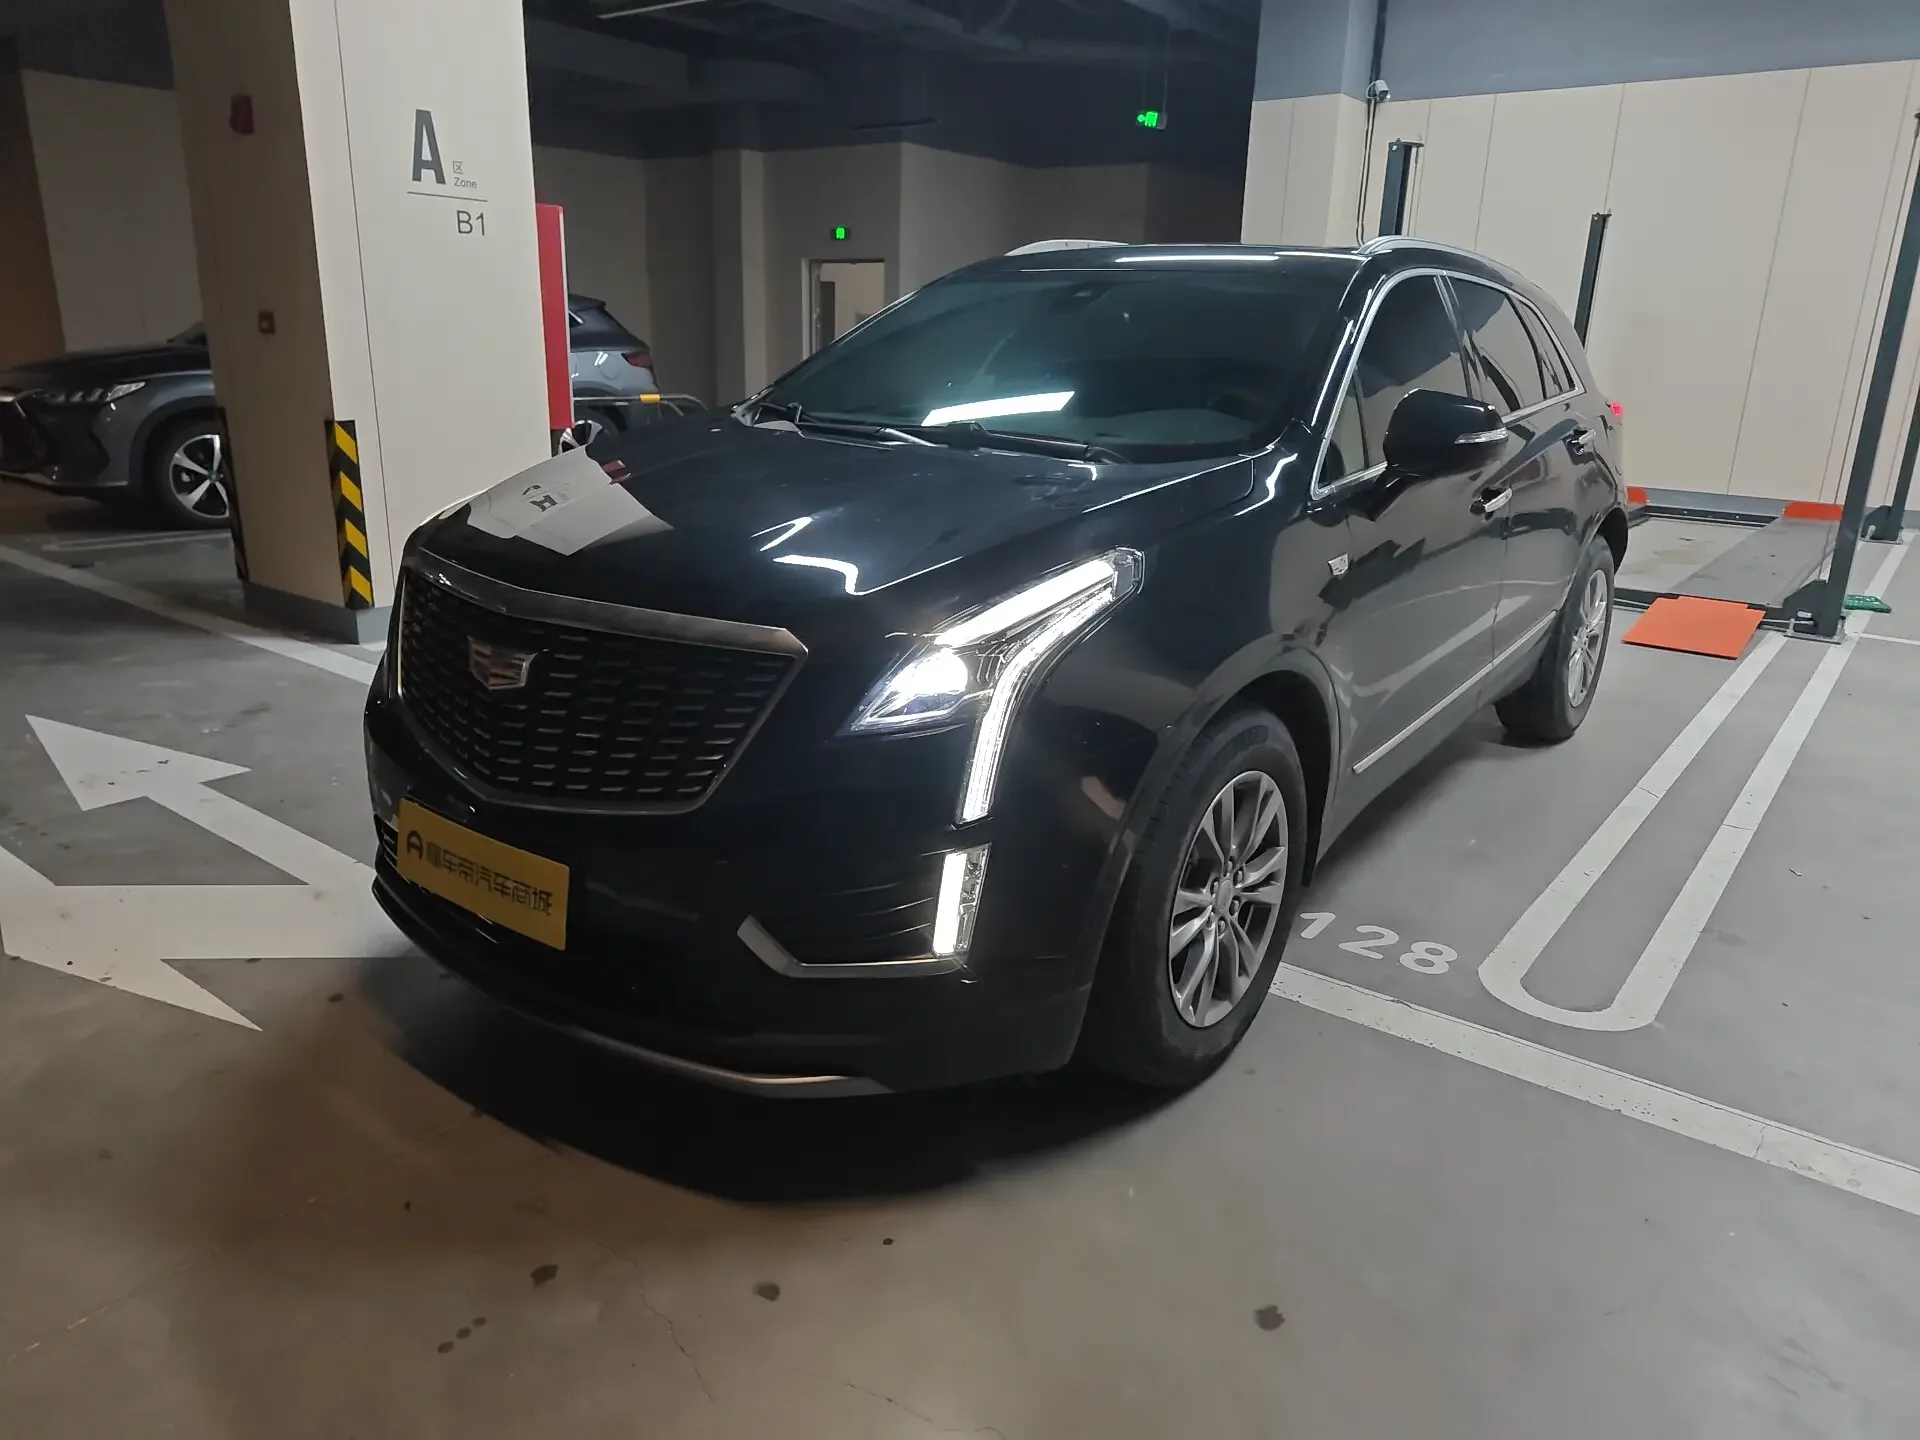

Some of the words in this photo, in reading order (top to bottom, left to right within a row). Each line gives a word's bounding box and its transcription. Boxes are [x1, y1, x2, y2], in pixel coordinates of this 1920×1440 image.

[412, 109, 446, 185] A
[452, 160, 464, 175] 区
[453, 177, 477, 189] Zone
[456, 209, 486, 236] B1
[1300, 912, 1458, 975] 128
